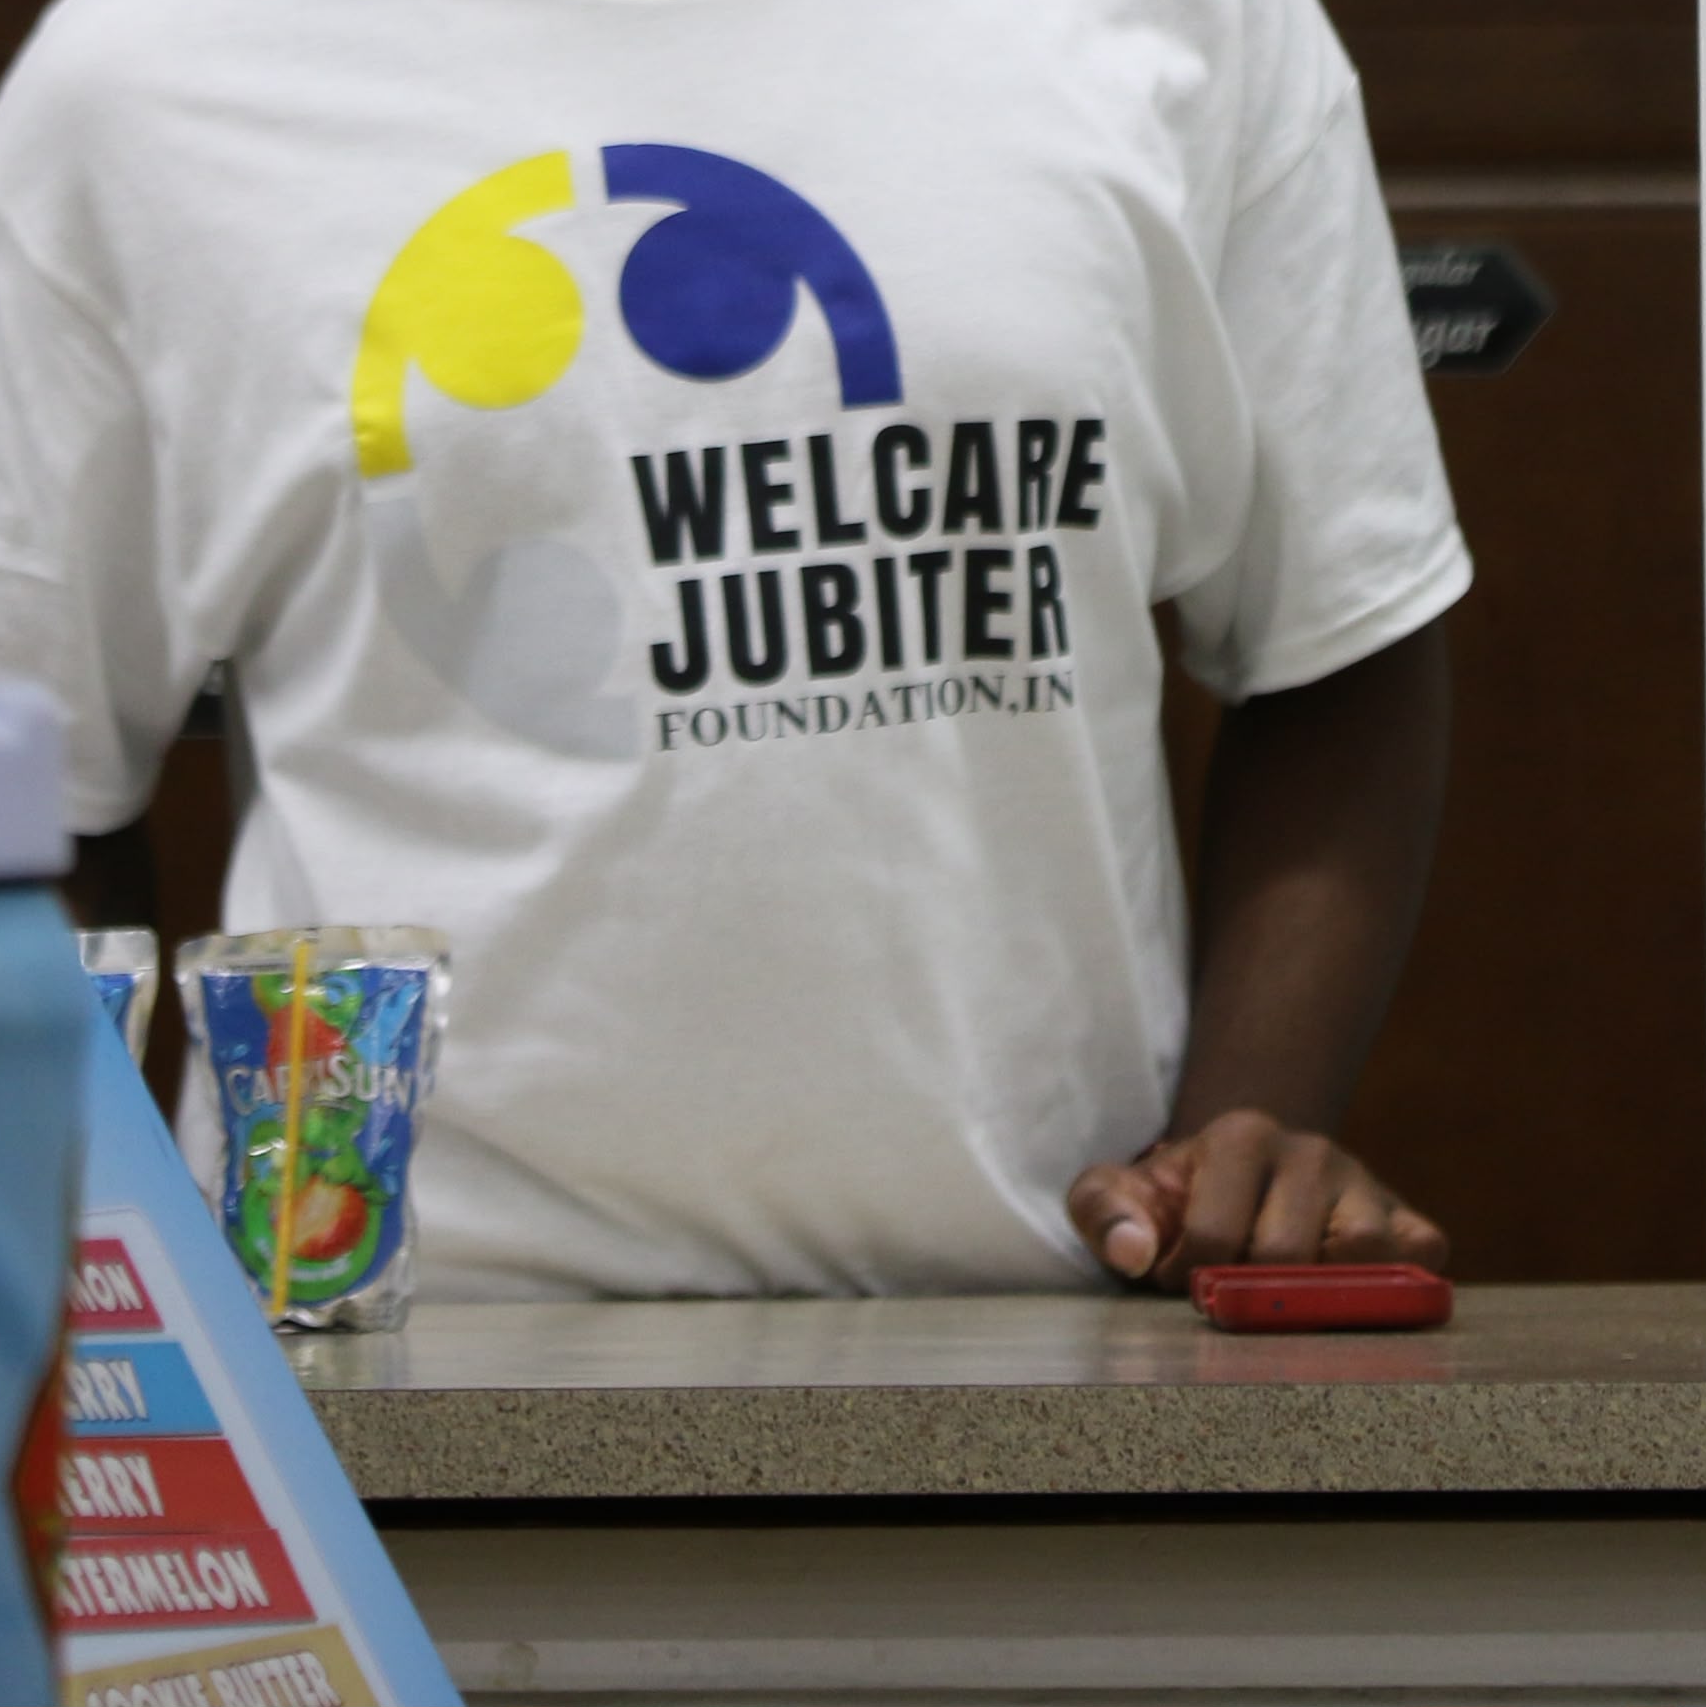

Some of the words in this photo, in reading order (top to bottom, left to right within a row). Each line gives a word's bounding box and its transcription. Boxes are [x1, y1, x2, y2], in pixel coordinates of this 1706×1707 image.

[1413, 320, 1499, 371] gar
[631, 419, 1106, 565] WELCARE
[650, 544, 1069, 695] JUBITER
